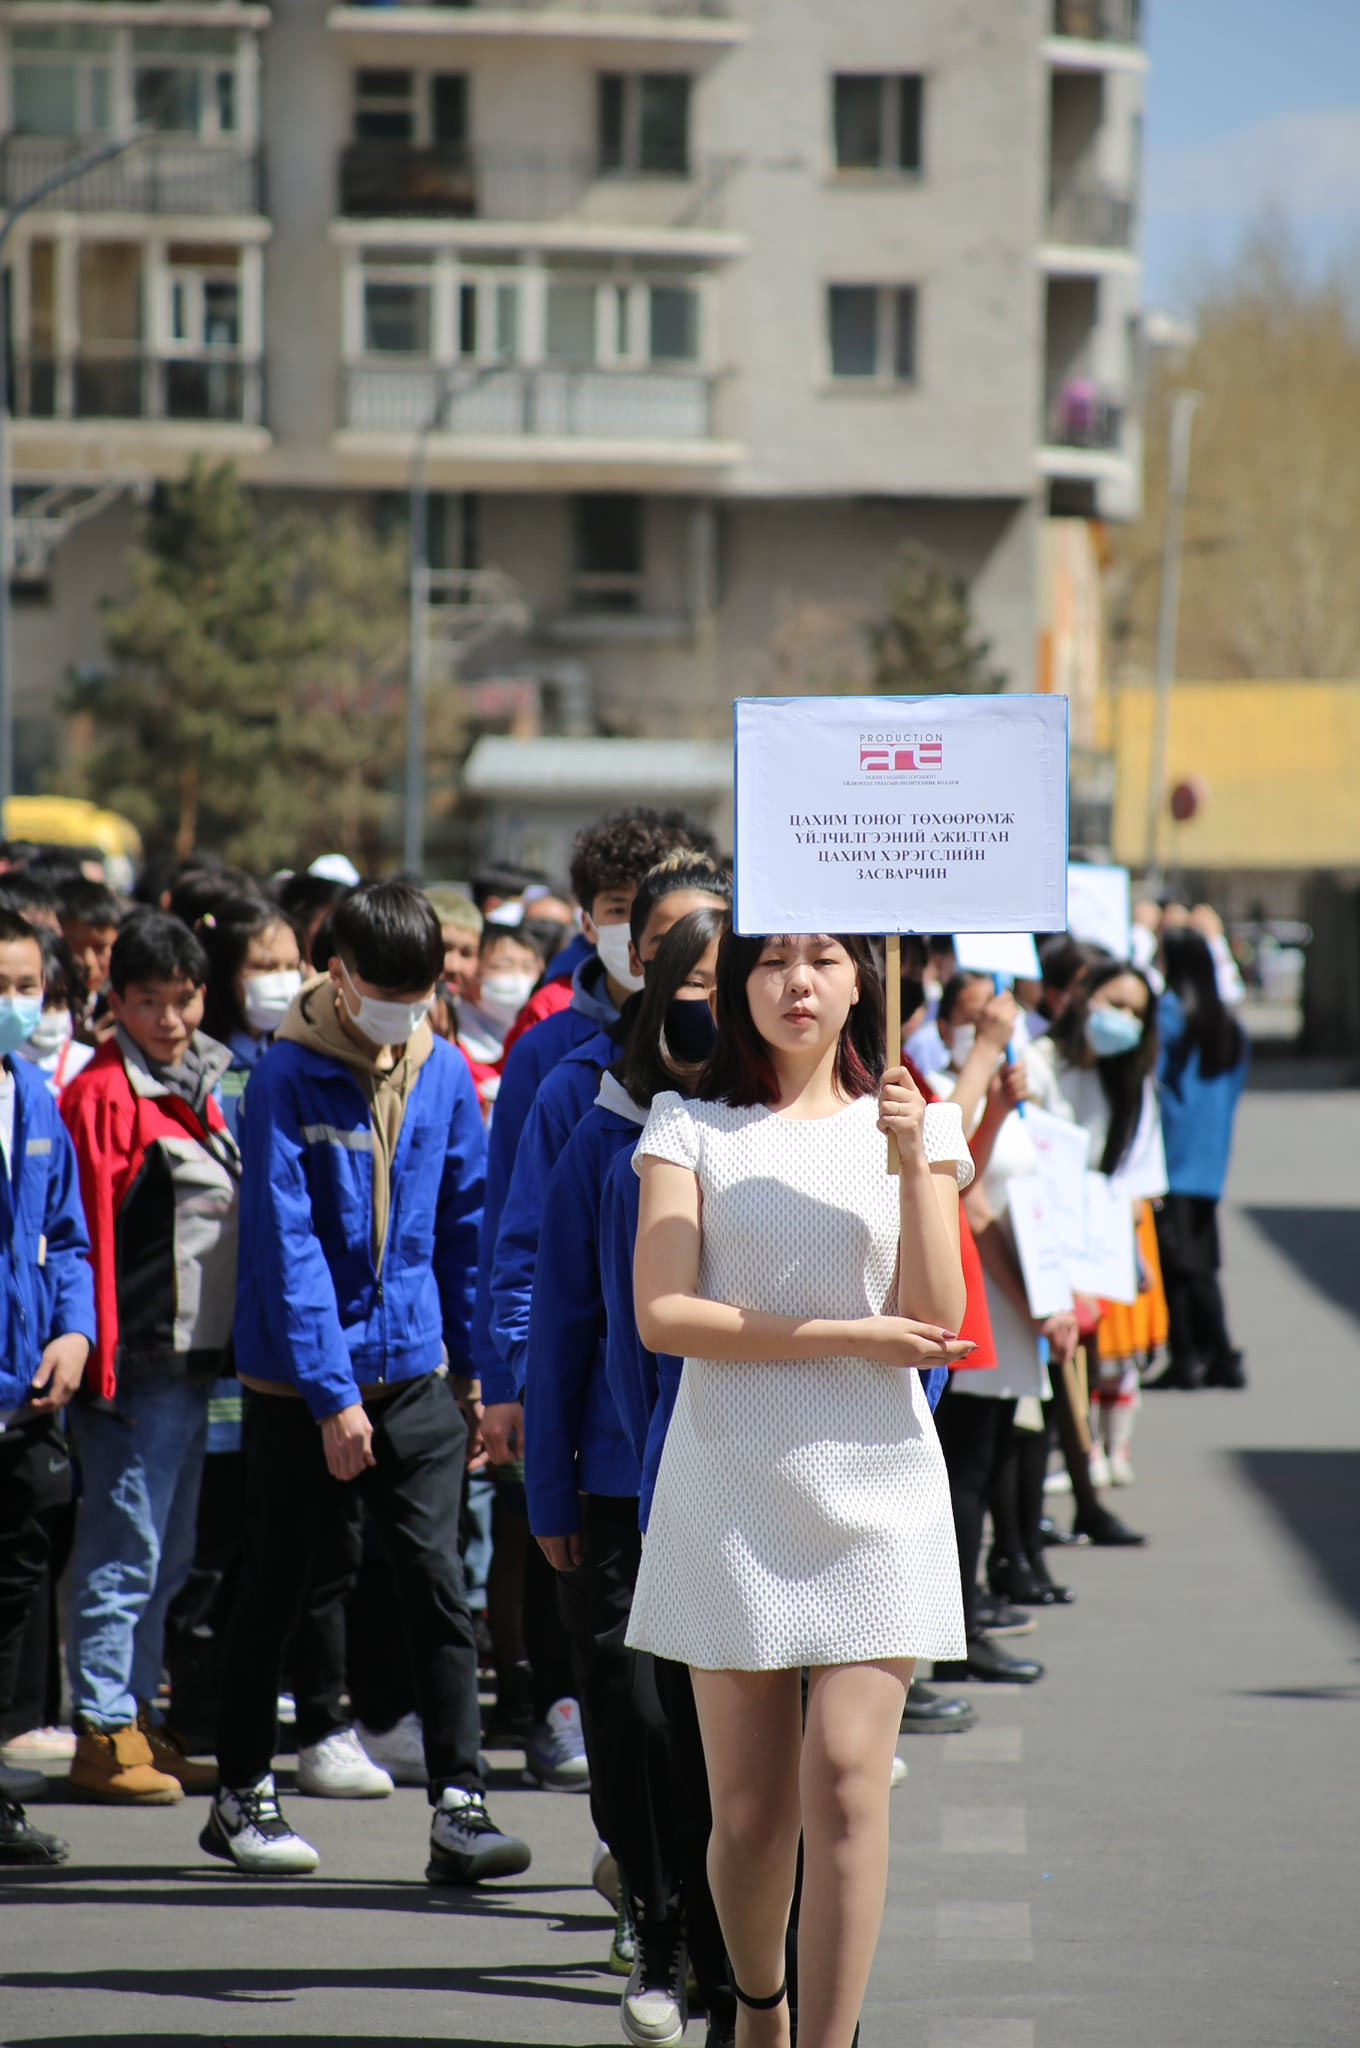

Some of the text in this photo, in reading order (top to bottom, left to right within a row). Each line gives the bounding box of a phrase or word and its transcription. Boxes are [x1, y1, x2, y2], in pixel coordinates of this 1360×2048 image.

[859, 733, 943, 743] PRODUCTION
[789, 812, 1016, 827] ЦАХИМ ТОНОГ ТӨХӨӨРӨМЖ
[794, 830, 1009, 844] ҮЙЛЧИЛГЭЭНИЙ АЖИЛТАН
[818, 847, 986, 863] ЦАХИМ ХЭРЭГСЛИЙН
[856, 867, 947, 880] ЗАСВАРЧИН
